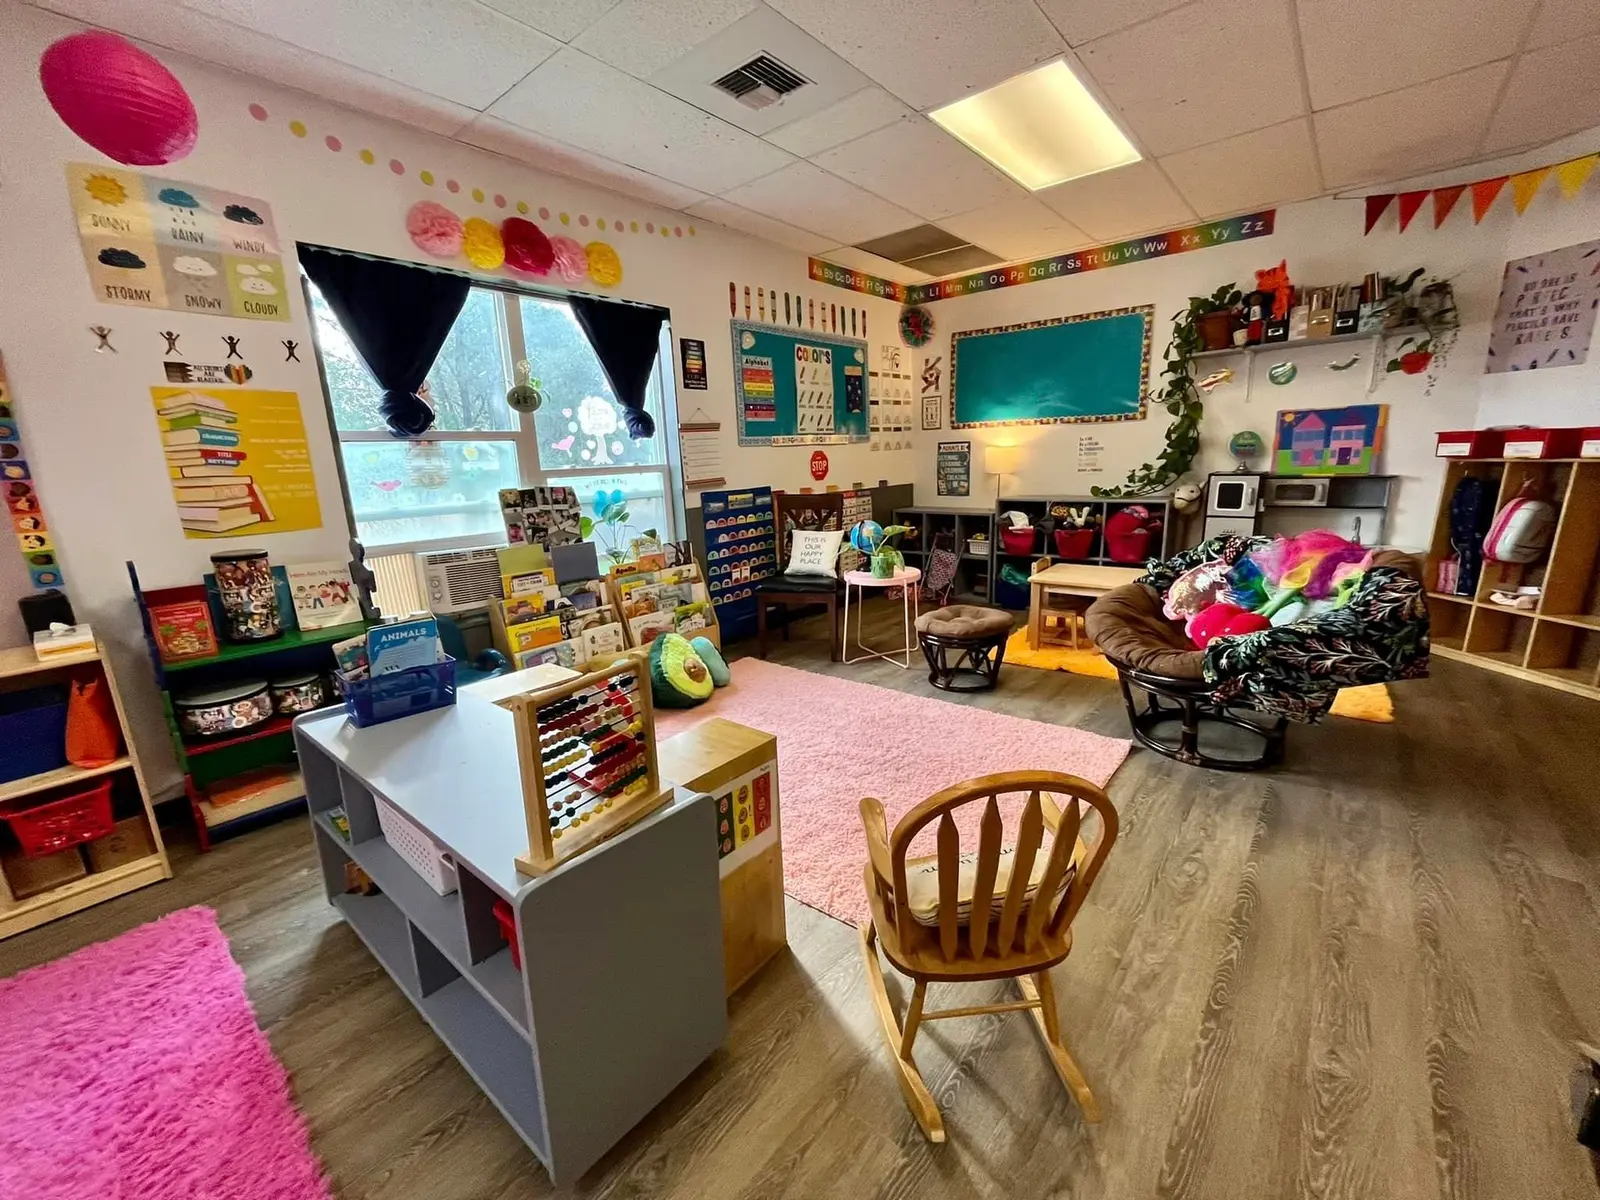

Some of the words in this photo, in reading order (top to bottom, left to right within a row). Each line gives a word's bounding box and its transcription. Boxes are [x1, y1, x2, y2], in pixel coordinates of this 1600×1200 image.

[171, 227, 204, 244] RAINY
[232, 239, 265, 254] WINDY
[1067, 259, 1082, 269] Ss
[1102, 251, 1119, 262] Uu
[1123, 247, 1140, 257] Vv
[1144, 241, 1168, 253] Ww
[1211, 227, 1232, 240] Yy
[1241, 221, 1264, 234] Zz
[104, 285, 151, 301] STORMY
[185, 294, 222, 310] SNOWY
[244, 301, 278, 316] CLOUDY
[812, 460, 827, 472] STOP
[380, 627, 427, 642] ANIMALS
